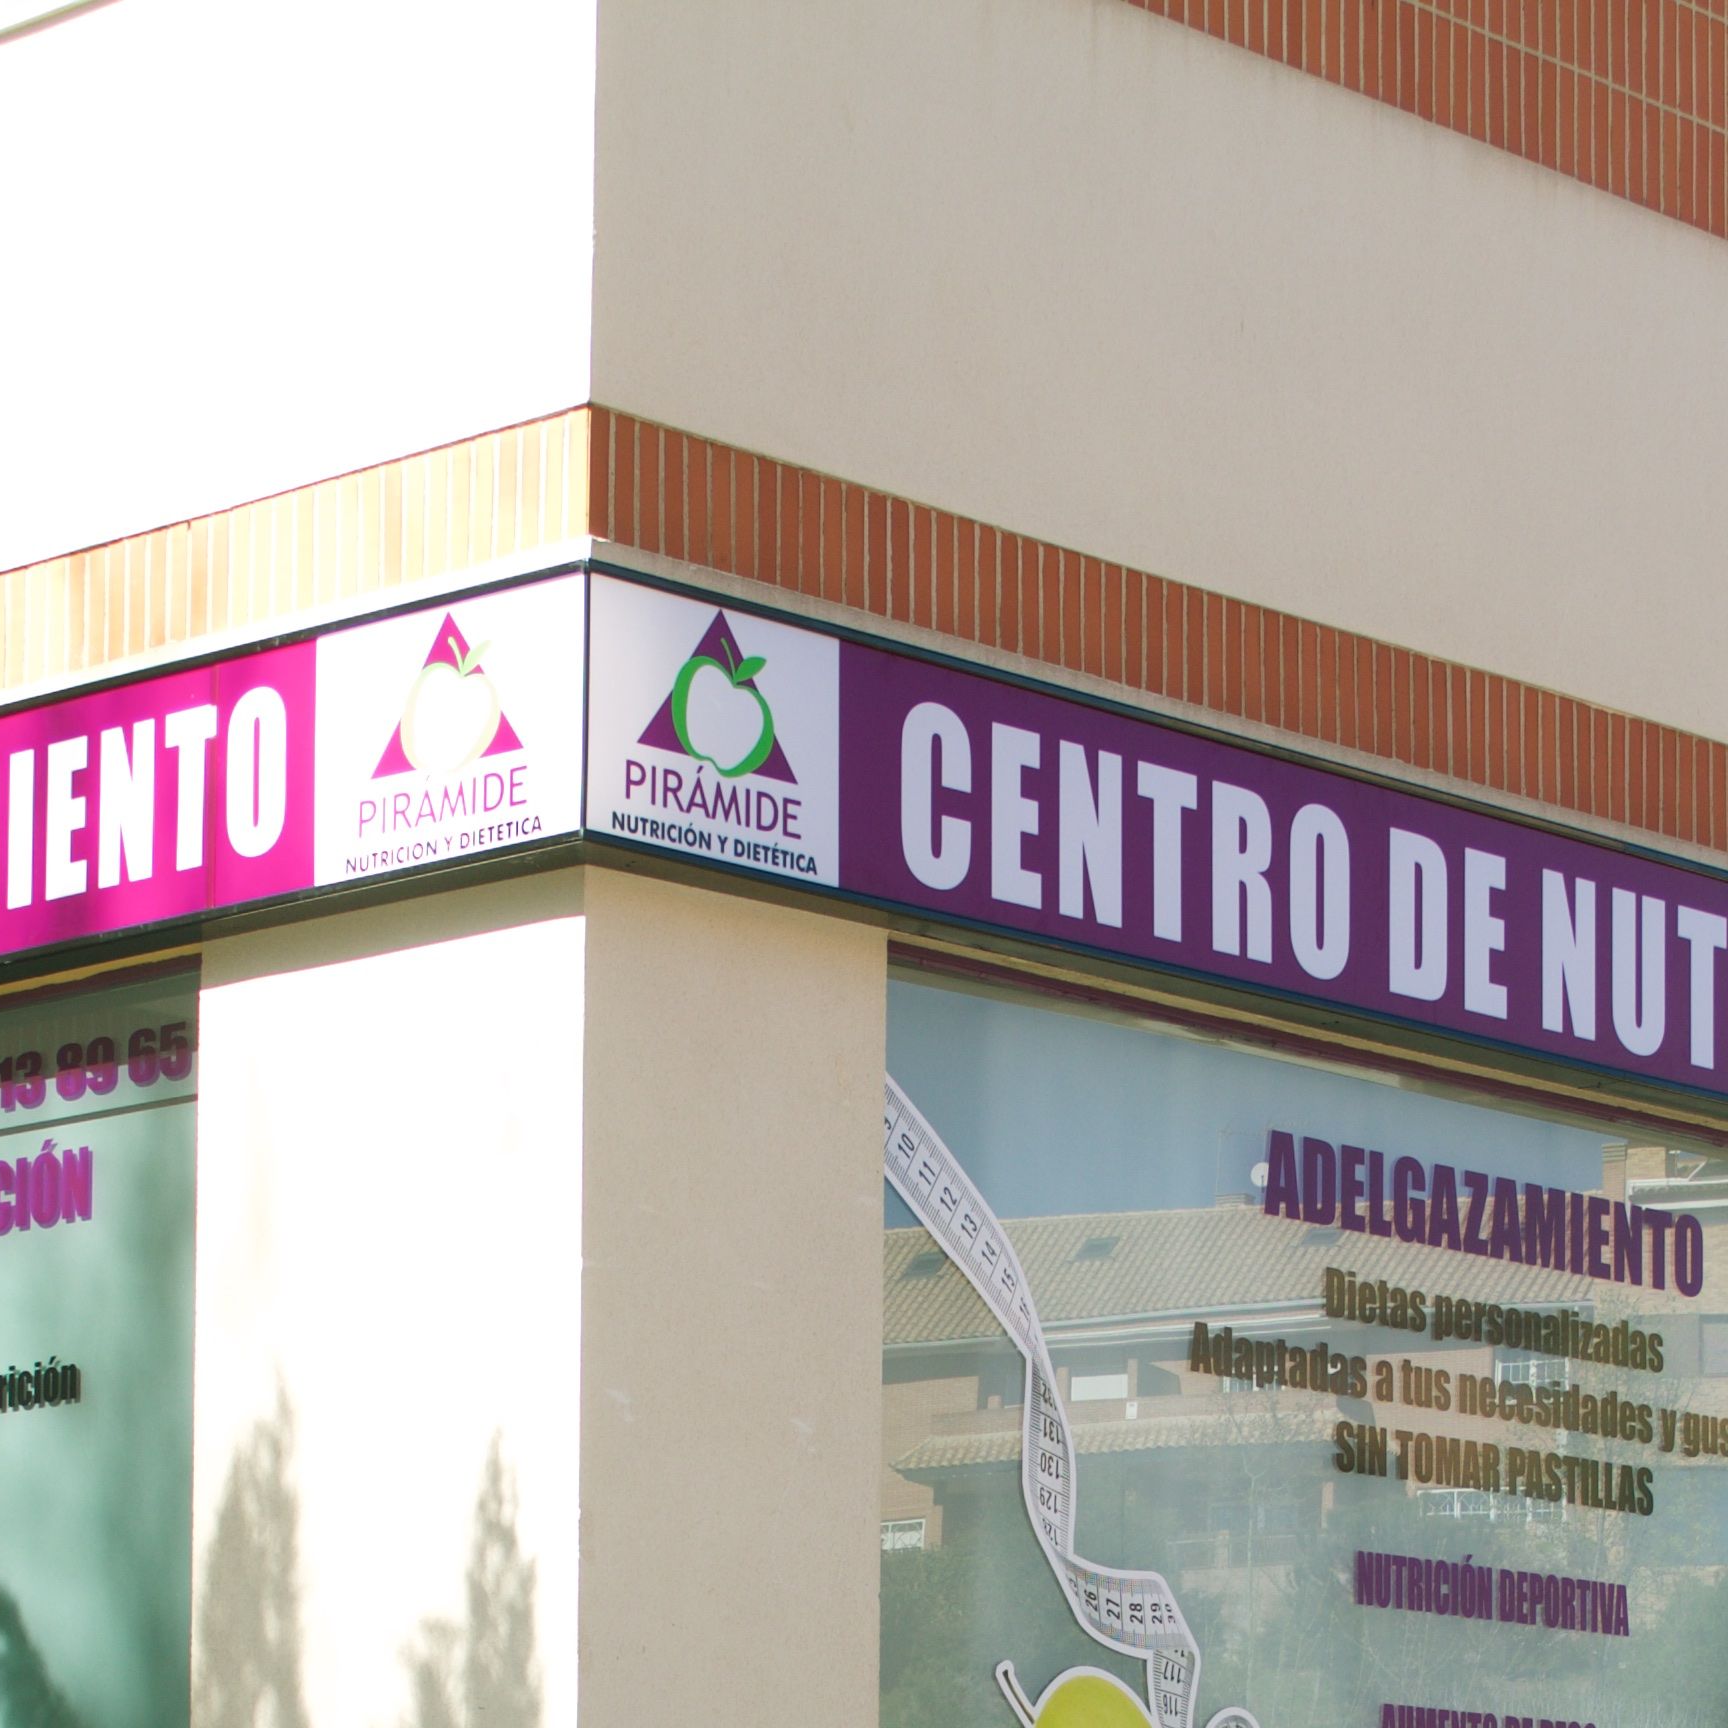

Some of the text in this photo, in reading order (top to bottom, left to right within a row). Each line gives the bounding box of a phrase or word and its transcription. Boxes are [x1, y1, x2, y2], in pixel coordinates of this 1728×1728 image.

[624, 758, 802, 841] PIRÁMIDE
[444, 836, 454, 852] Y
[611, 810, 818, 876] NUTRICIÓN Y DIETÉTICA
[900, 701, 1351, 981] CENTRO
[1388, 826, 1508, 1020] DE
[55, 1036, 119, 1102] 89
[127, 1021, 193, 1088] 65
[897, 1132, 915, 1158] 10
[919, 1160, 936, 1186] 11
[939, 1186, 957, 1212] 12
[960, 1213, 978, 1239] 13
[1263, 1128, 1704, 1298] ADELGAZAMIENTO
[981, 1240, 996, 1266] 14
[1001, 1267, 1016, 1293] 15
[1325, 1266, 1665, 1374] Dietas personalizadas
[1190, 1321, 1368, 1400] Adaptadas
[1374, 1359, 1394, 1403] a
[1401, 1359, 1452, 1412] tus
[1458, 1371, 1654, 1444] necesidades
[1658, 1407, 1677, 1453] y
[1042, 1417, 1061, 1445] 131
[1039, 1452, 1060, 1480] 130
[1333, 1420, 1655, 1517] SIN TOMAR PASTILLAS
[1038, 1486, 1059, 1514] 129
[1084, 1589, 1099, 1612] 26
[1354, 1550, 1630, 1637] NUTRICIÓN DEPORTIVA
[1106, 1597, 1121, 1620] 27
[1129, 1602, 1144, 1624] 28
[1151, 1602, 1163, 1624] 29
[1163, 1660, 1182, 1684] 117
[1162, 1694, 1179, 1717] 116
